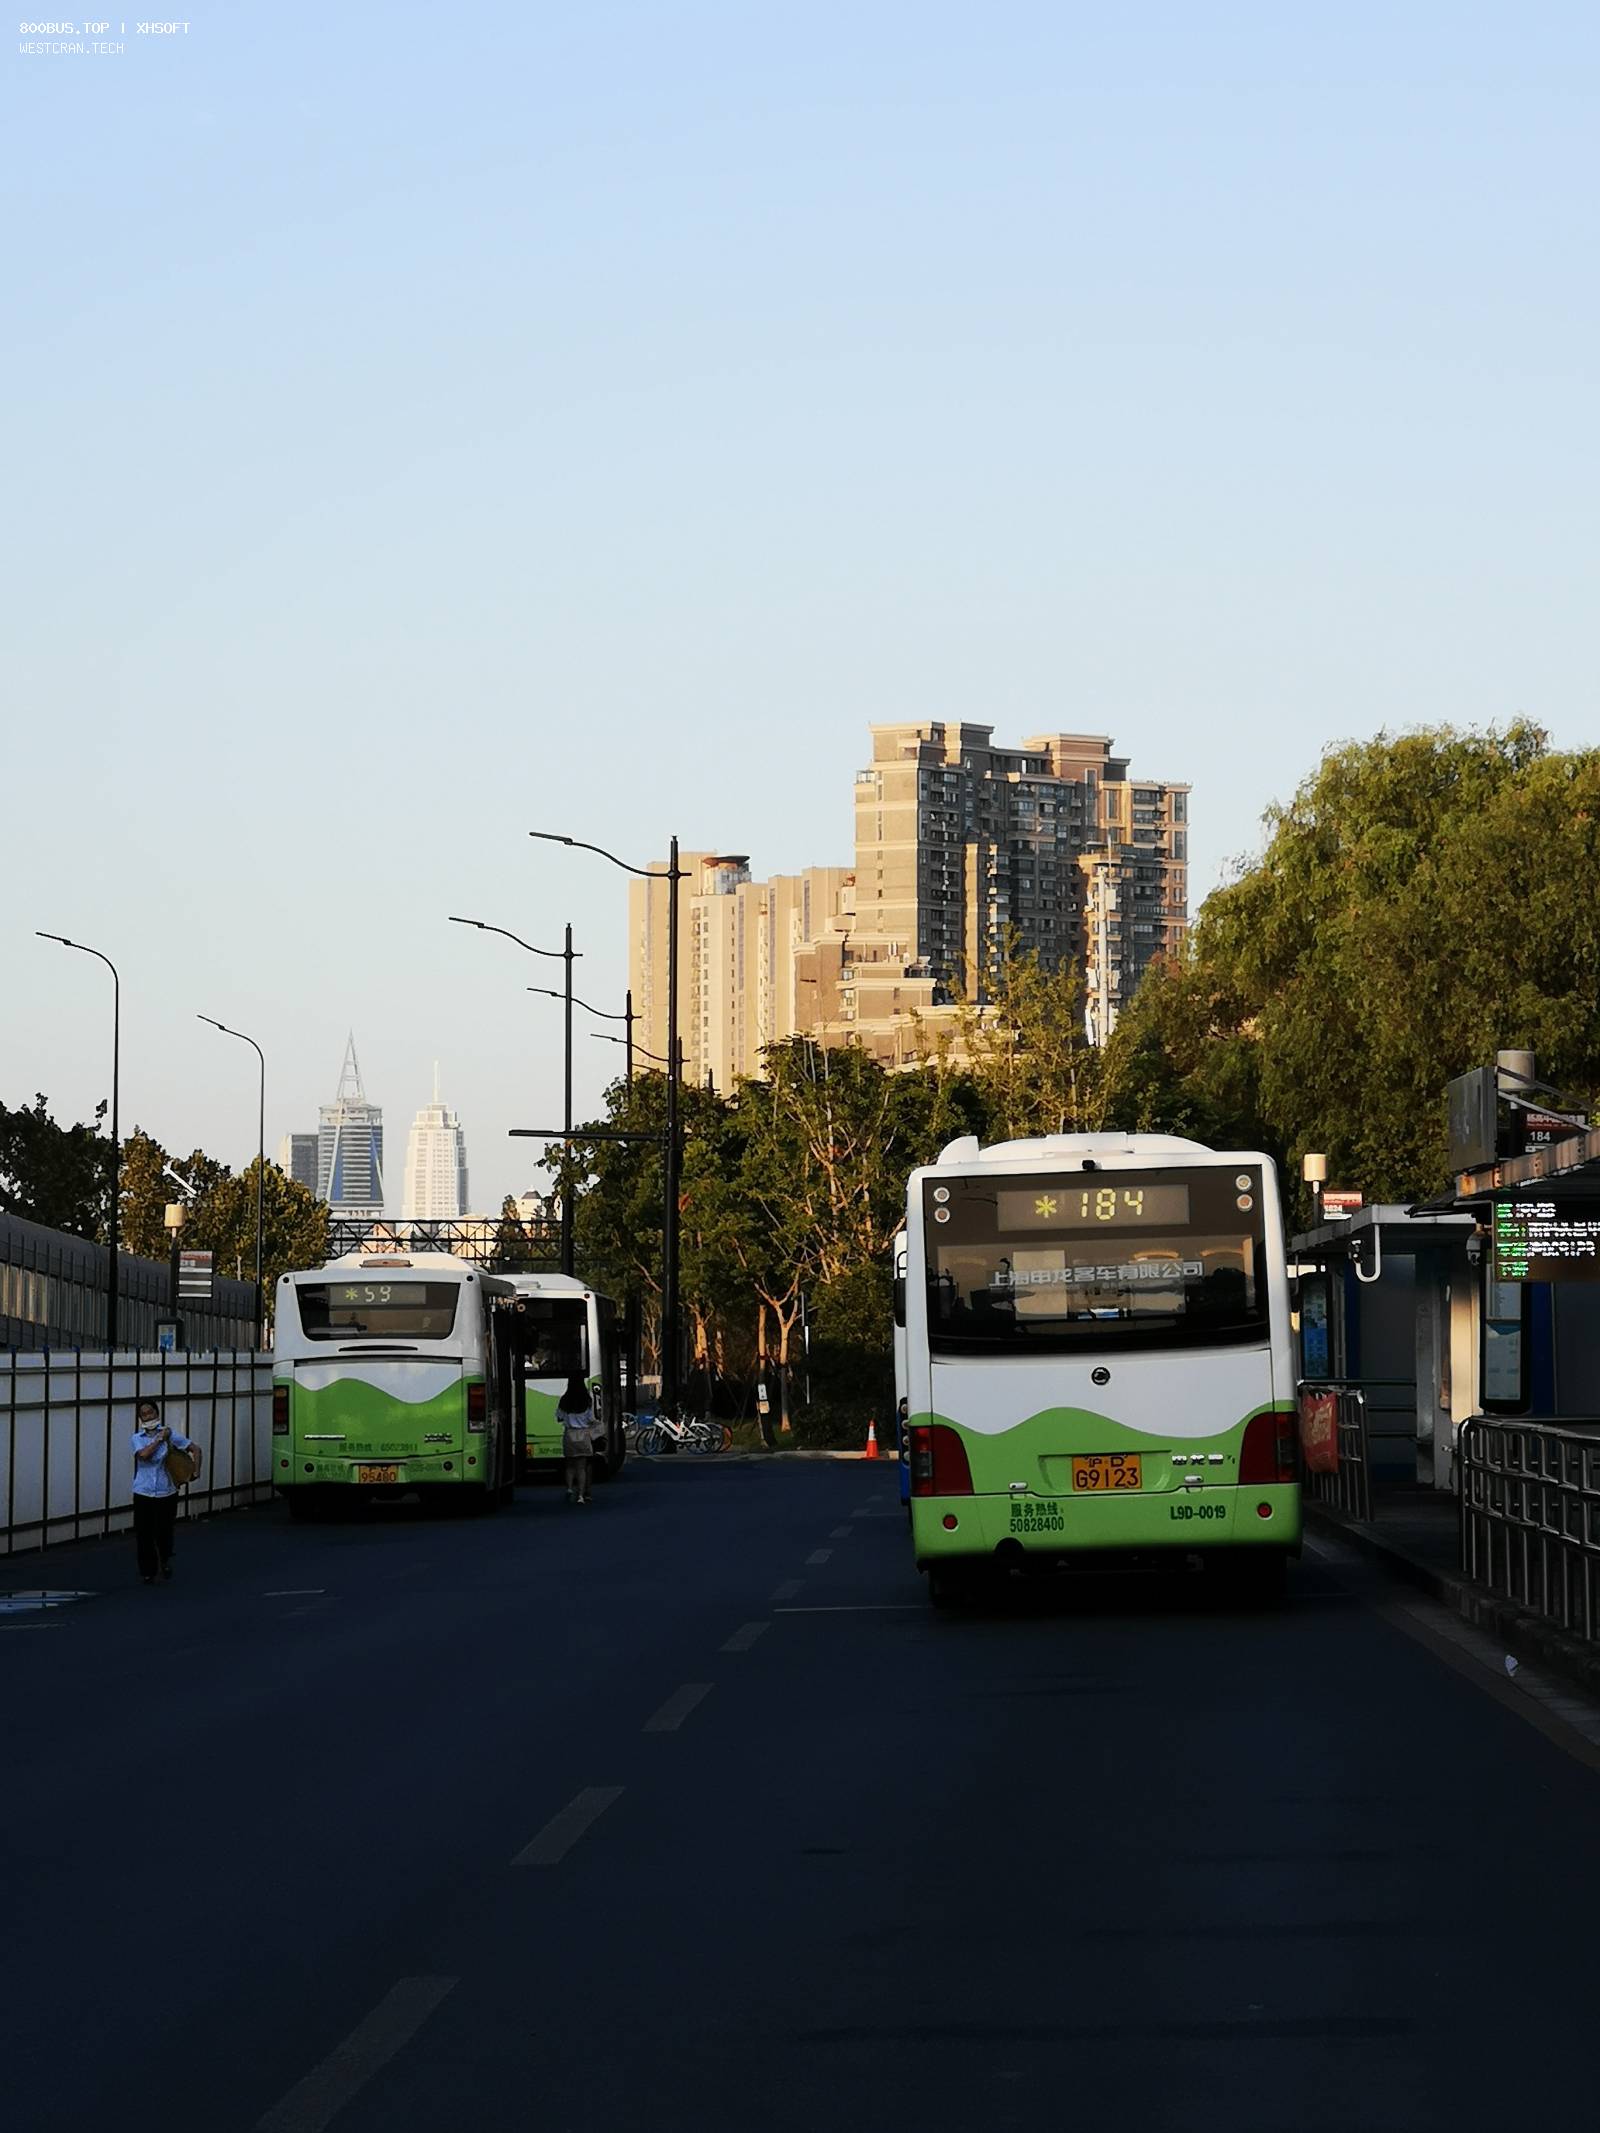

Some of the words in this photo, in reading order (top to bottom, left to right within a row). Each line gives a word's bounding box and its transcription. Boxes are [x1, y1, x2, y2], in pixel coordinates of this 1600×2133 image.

[1530, 1131, 1551, 1142] 184
[1081, 1188, 1143, 1221] 184
[989, 1261, 1203, 1286] 上海申龙客车有限公司
[364, 1285, 392, 1302] 59
[1076, 1467, 1139, 1489] G9123
[1170, 1505, 1226, 1520] L9D-0019
[1010, 1516, 1064, 1532] 50828400
